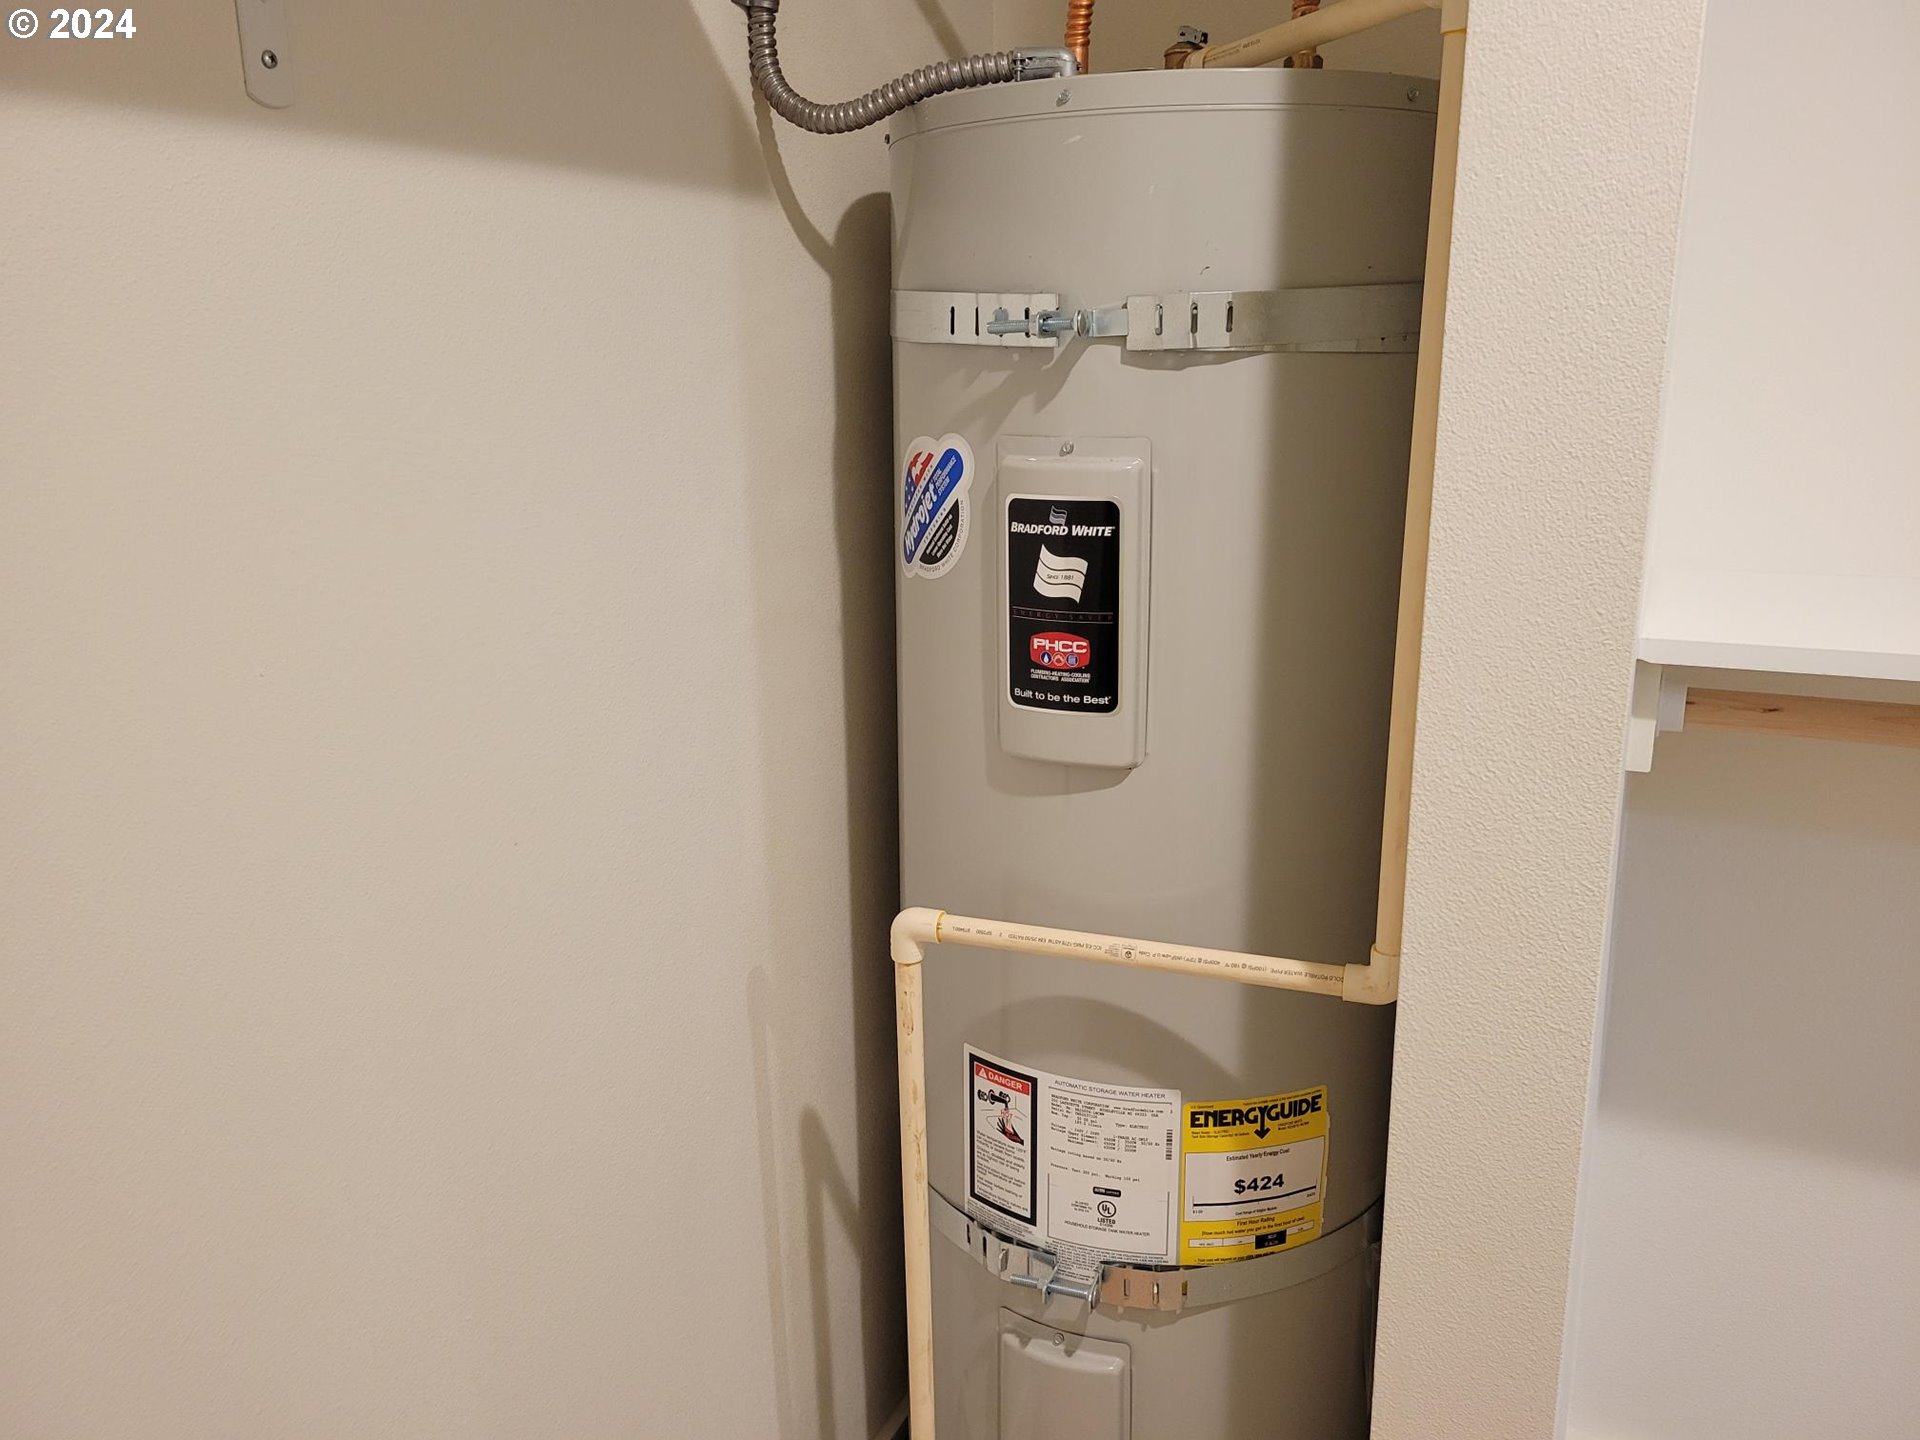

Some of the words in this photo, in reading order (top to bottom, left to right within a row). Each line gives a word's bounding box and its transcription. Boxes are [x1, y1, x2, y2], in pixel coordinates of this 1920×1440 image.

[904, 483, 938, 556] Hydrojet
[953, 500, 965, 552] CORPORATION
[1010, 522, 1068, 536] BRADFORD
[1014, 610, 1059, 620] ENERGY
[1033, 638, 1087, 653] PHCC
[1014, 688, 1033, 699] Built
[1047, 692, 1060, 701] be
[1063, 694, 1080, 703] the
[1083, 696, 1109, 704] Best
[1304, 972, 1327, 980] POTABLE
[988, 1072, 1022, 1090] DANGER
[1054, 1080, 1087, 1091] AUTOMATIC
[1088, 1086, 1116, 1095] STORAGE
[1190, 1094, 1322, 1128] ENERGYGUIDE
[1234, 1174, 1284, 1195] $424
[1102, 1204, 1112, 1215] UL
